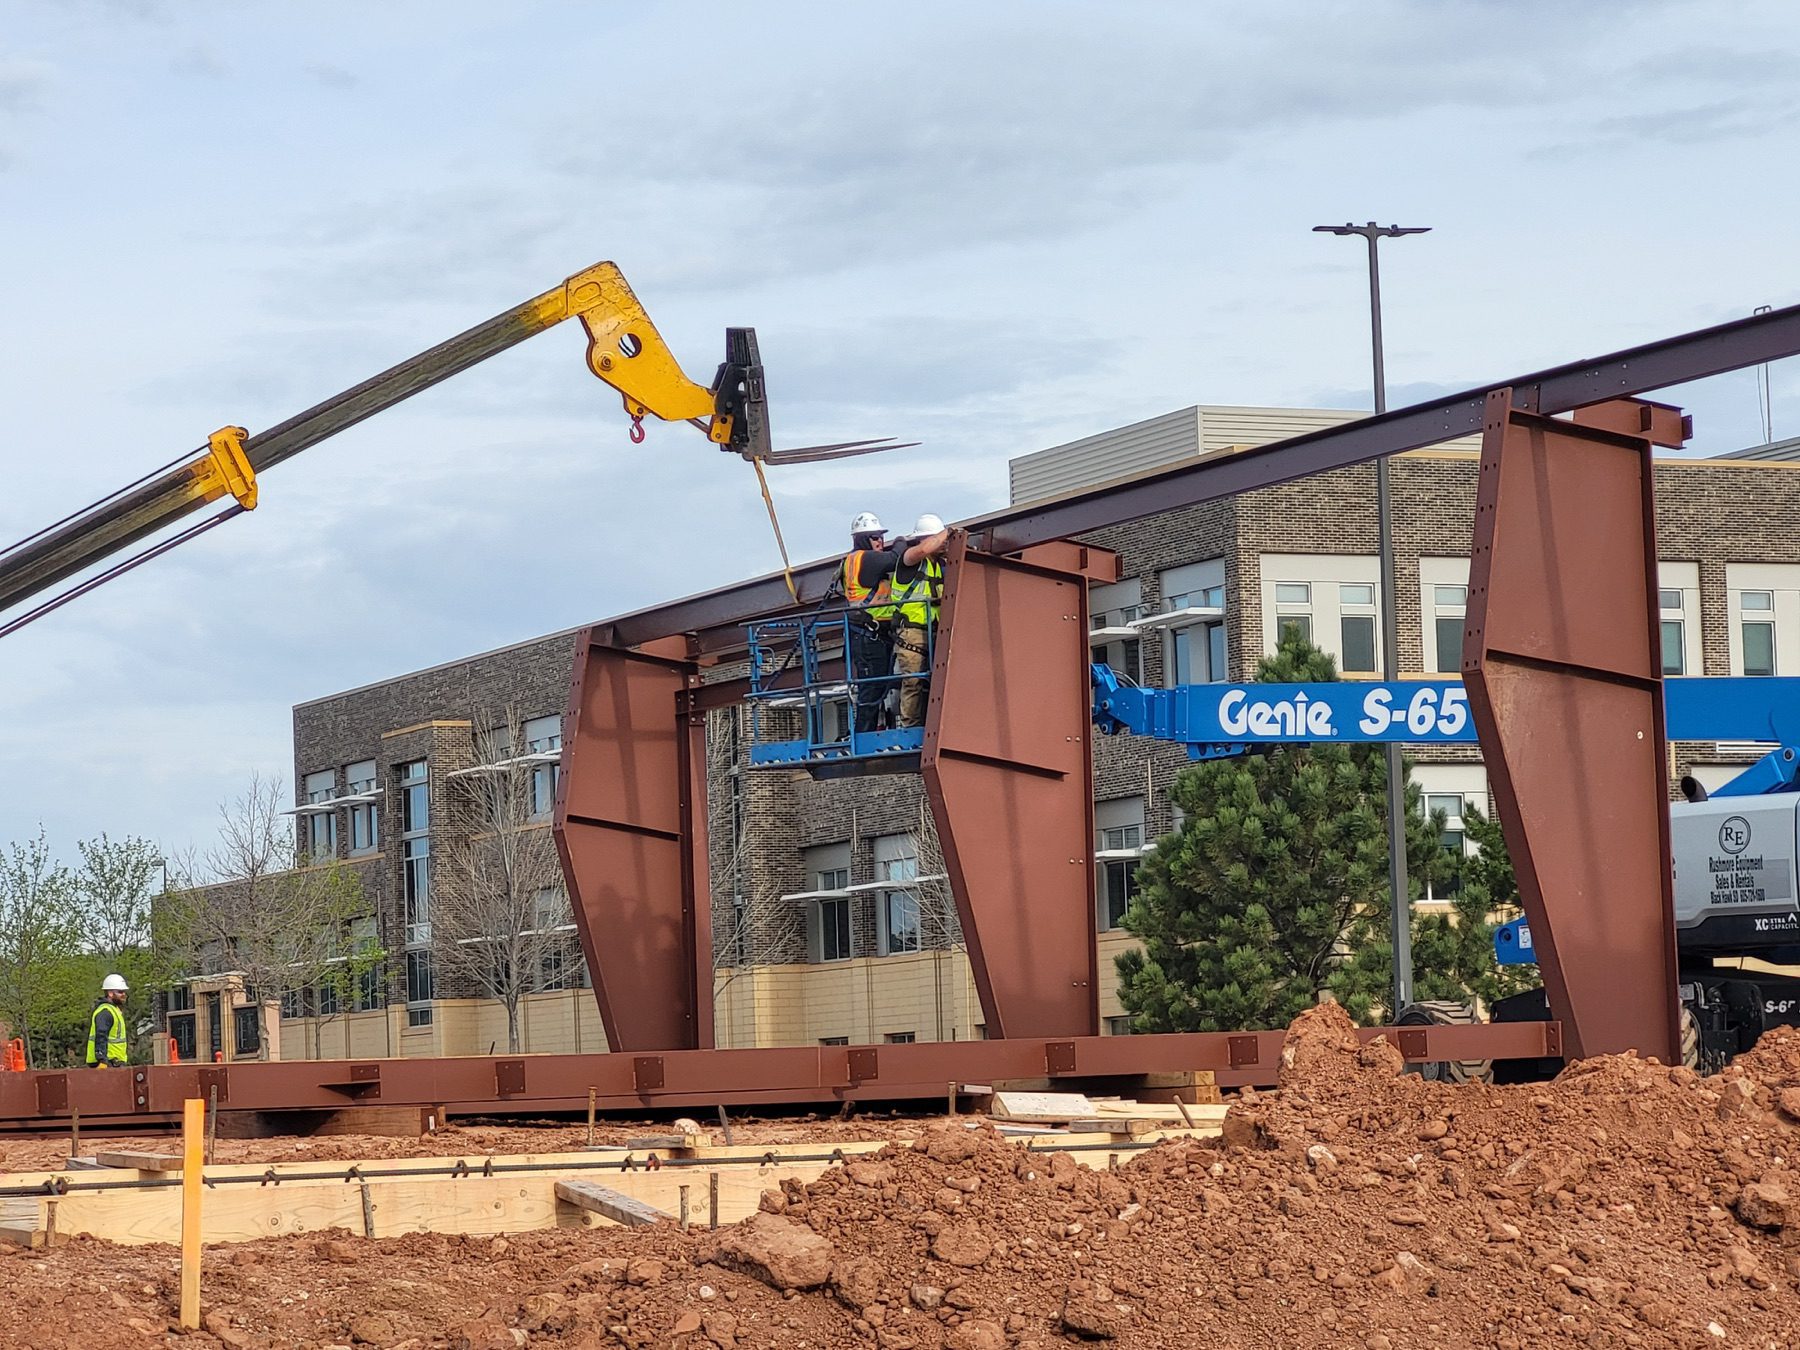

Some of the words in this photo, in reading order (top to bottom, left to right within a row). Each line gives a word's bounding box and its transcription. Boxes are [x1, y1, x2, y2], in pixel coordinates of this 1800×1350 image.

[1218, 690, 1333, 736] Genie
[1359, 687, 1467, 736] S-65
[1709, 857, 1734, 873] Rushmore
[1736, 854, 1763, 875] Equipment
[1715, 874, 1729, 889] Sales
[1736, 873, 1754, 888] Rentals
[1754, 918, 1769, 931] XC
